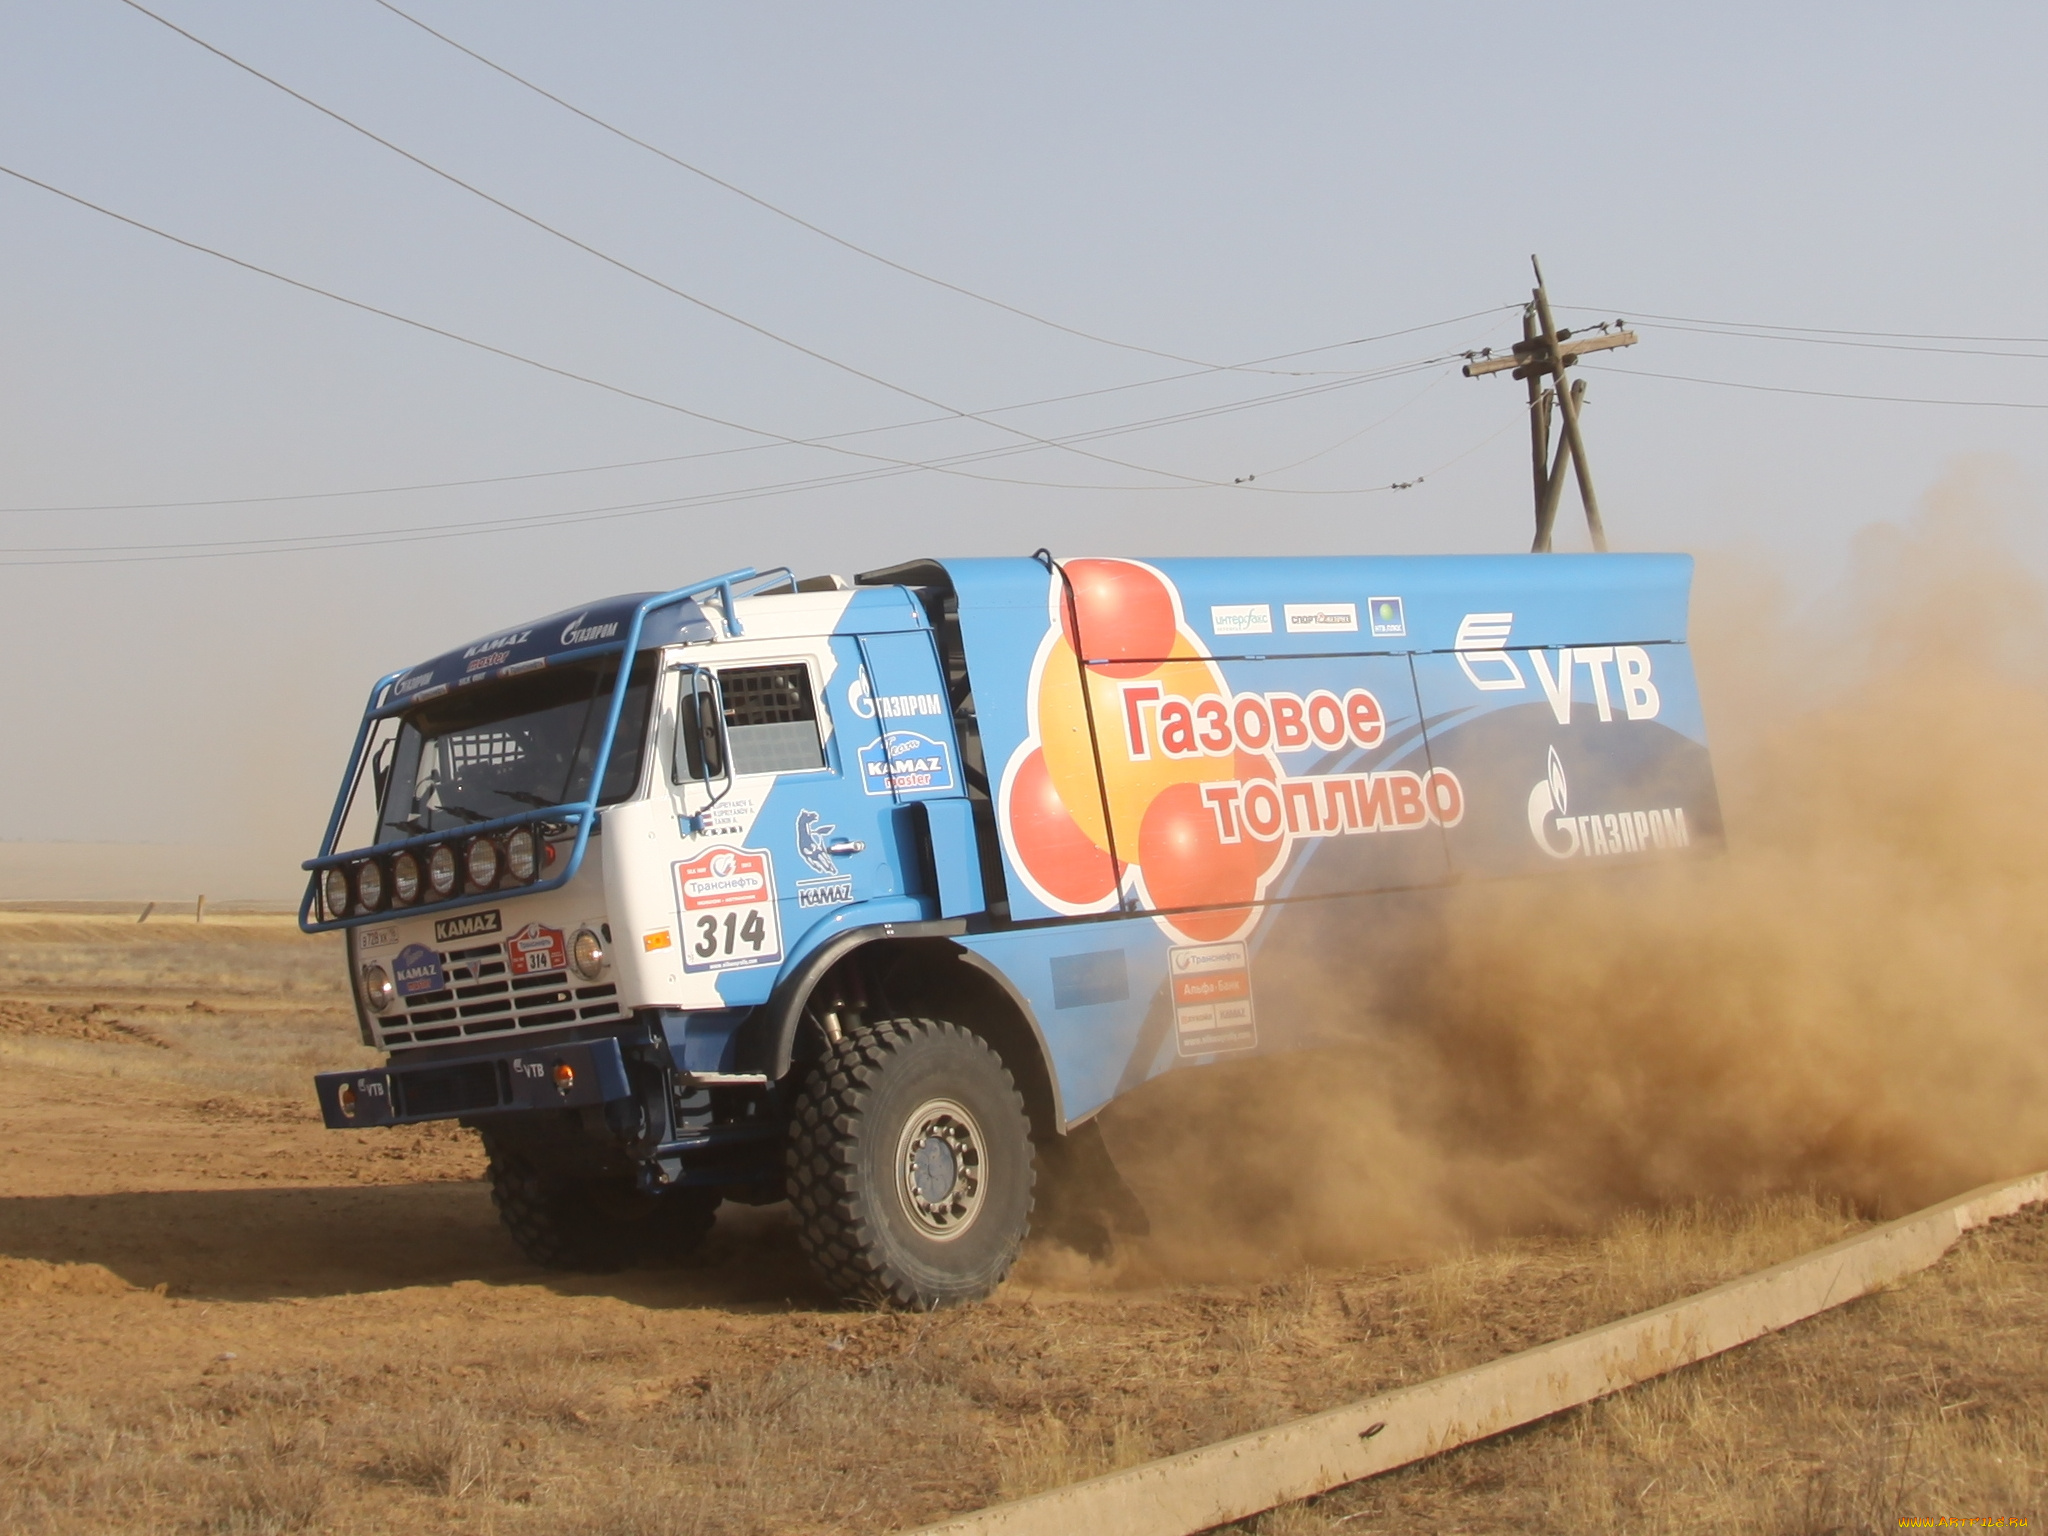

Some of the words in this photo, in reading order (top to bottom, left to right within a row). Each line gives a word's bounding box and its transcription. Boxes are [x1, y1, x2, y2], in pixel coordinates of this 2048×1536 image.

[463, 630, 533, 659] KAMAZ
[1528, 645, 1660, 725] VTB
[876, 693, 942, 718] ГАЗПРОМ
[1117, 680, 1386, 761] Газовое
[866, 757, 942, 776] KAMAZ
[884, 773, 931, 788] master
[1577, 807, 1690, 857] ГАЗПРОМ
[690, 877, 759, 894] Транснефть
[799, 884, 853, 907] KAMAZ
[437, 914, 497, 940] KAMAZ
[695, 909, 766, 958] 314
[397, 965, 437, 981] KAMAZ
[529, 953, 547, 971] 314
[523, 1063, 545, 1078] VTB
[366, 1083, 384, 1096] VTB
